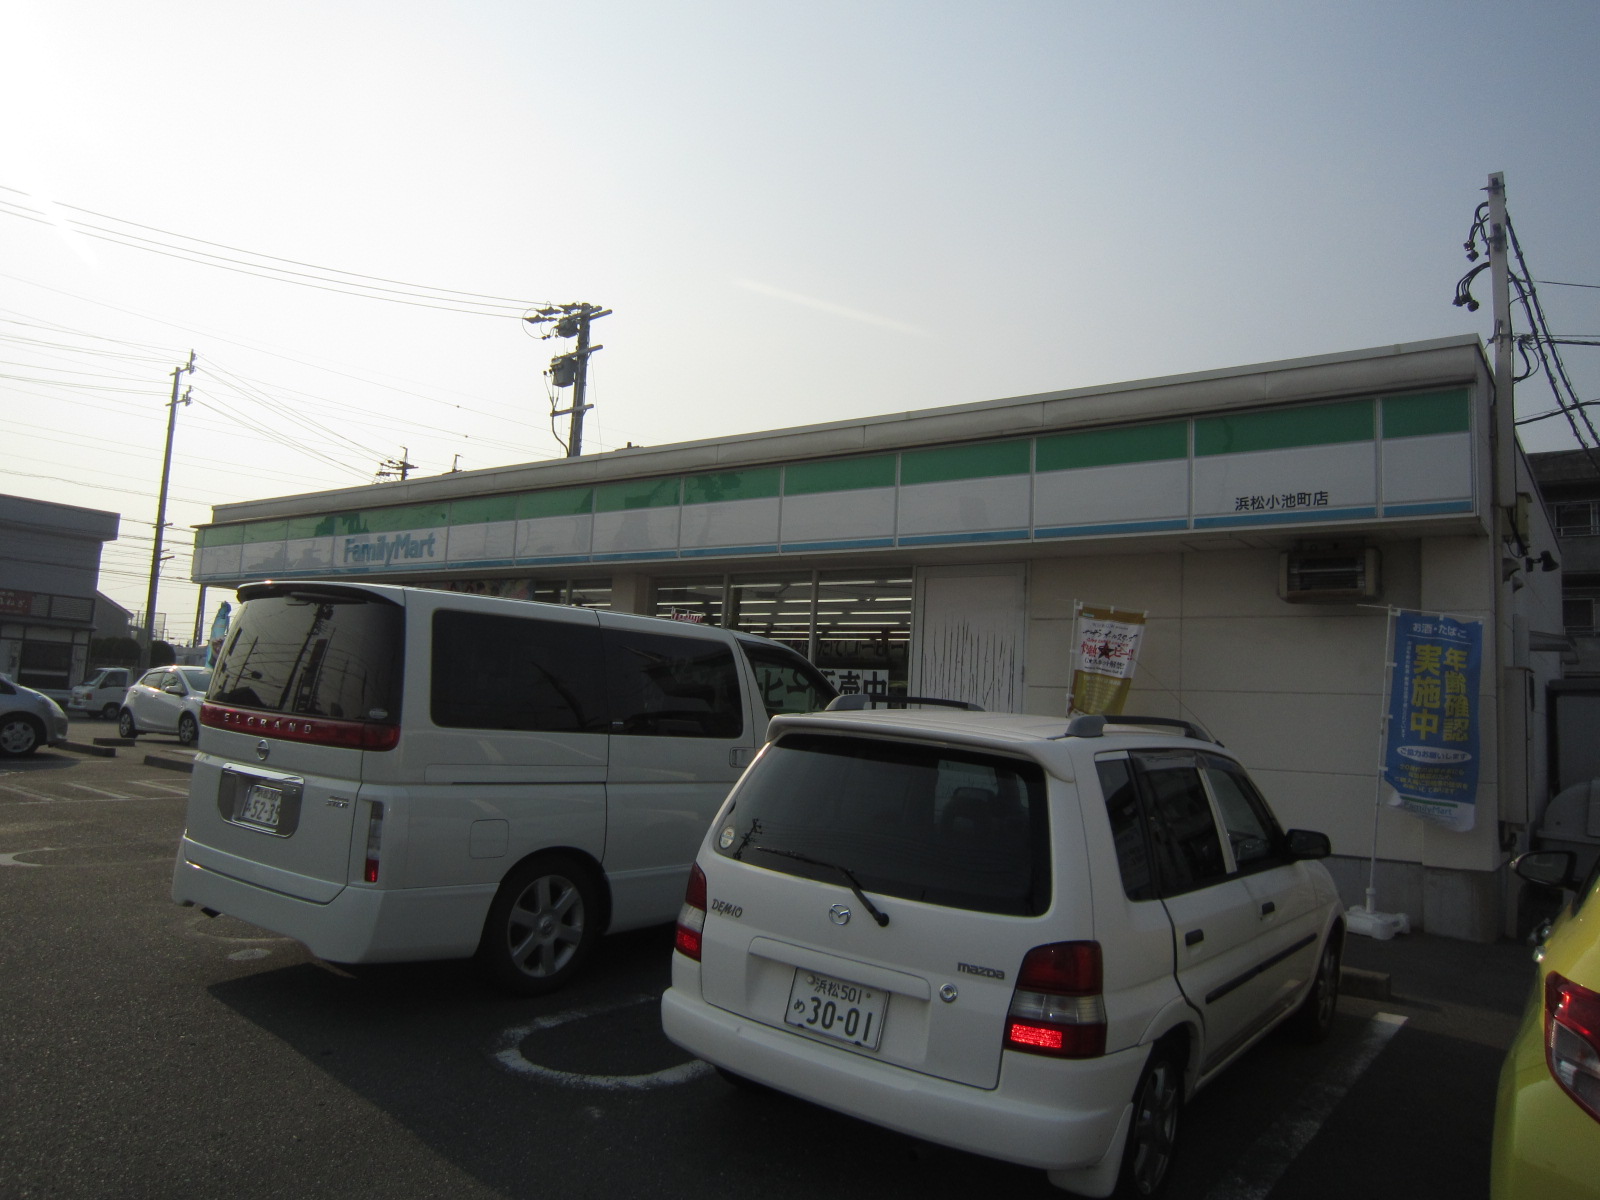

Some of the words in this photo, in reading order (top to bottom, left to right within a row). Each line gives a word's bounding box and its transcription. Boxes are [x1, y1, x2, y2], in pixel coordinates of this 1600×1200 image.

[1235, 490, 1328, 511] 浜松小池町店
[343, 532, 435, 567] FamilyMart
[1411, 644, 1443, 742] 実施中
[1443, 647, 1470, 742] 年齢確認
[224, 713, 312, 734] ELGRAND
[711, 897, 744, 919] DEMIO
[814, 977, 863, 1005] 浜松501
[792, 999, 806, 1015] め
[806, 996, 874, 1041] 30-01
